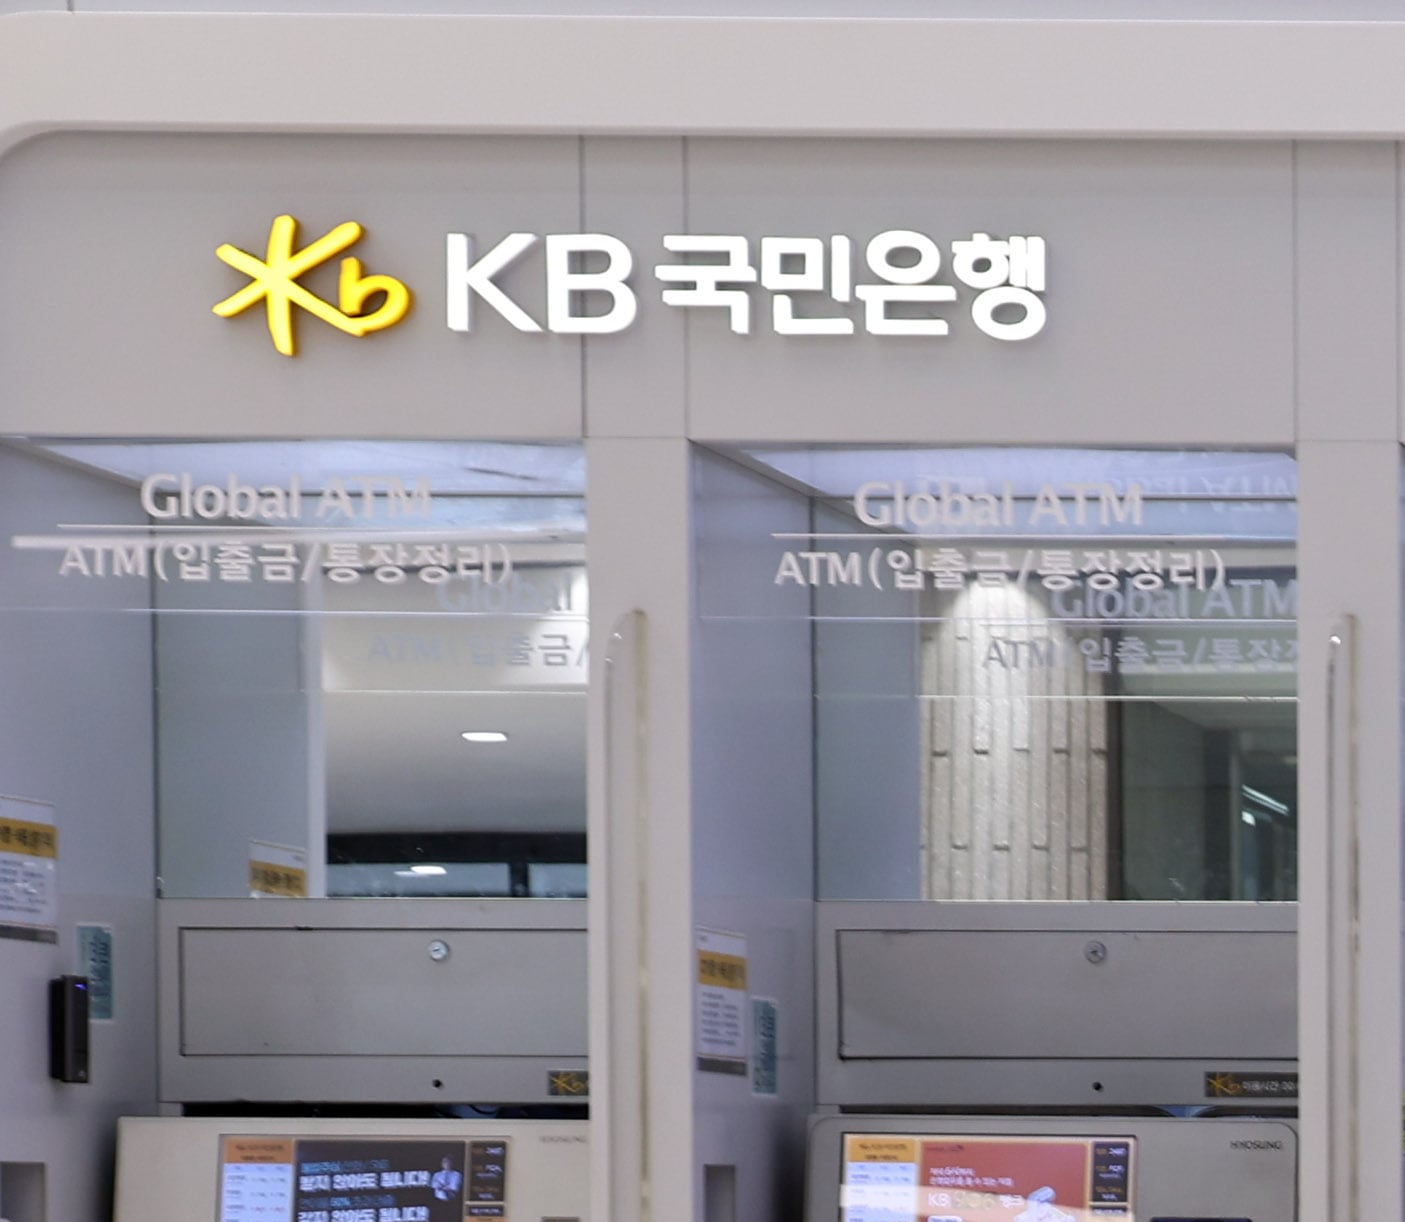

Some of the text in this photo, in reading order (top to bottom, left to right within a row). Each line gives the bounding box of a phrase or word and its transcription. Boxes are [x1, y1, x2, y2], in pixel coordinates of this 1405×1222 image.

[446, 229, 1049, 341] KB 국민은행
[140, 473, 433, 521] Global ATM
[853, 482, 1146, 527] Global ATM
[58, 540, 514, 583] ATM(입출금/통장정리)
[773, 549, 1225, 591] ATM(입출금/통장정리)
[1053, 579, 1190, 620] Global
